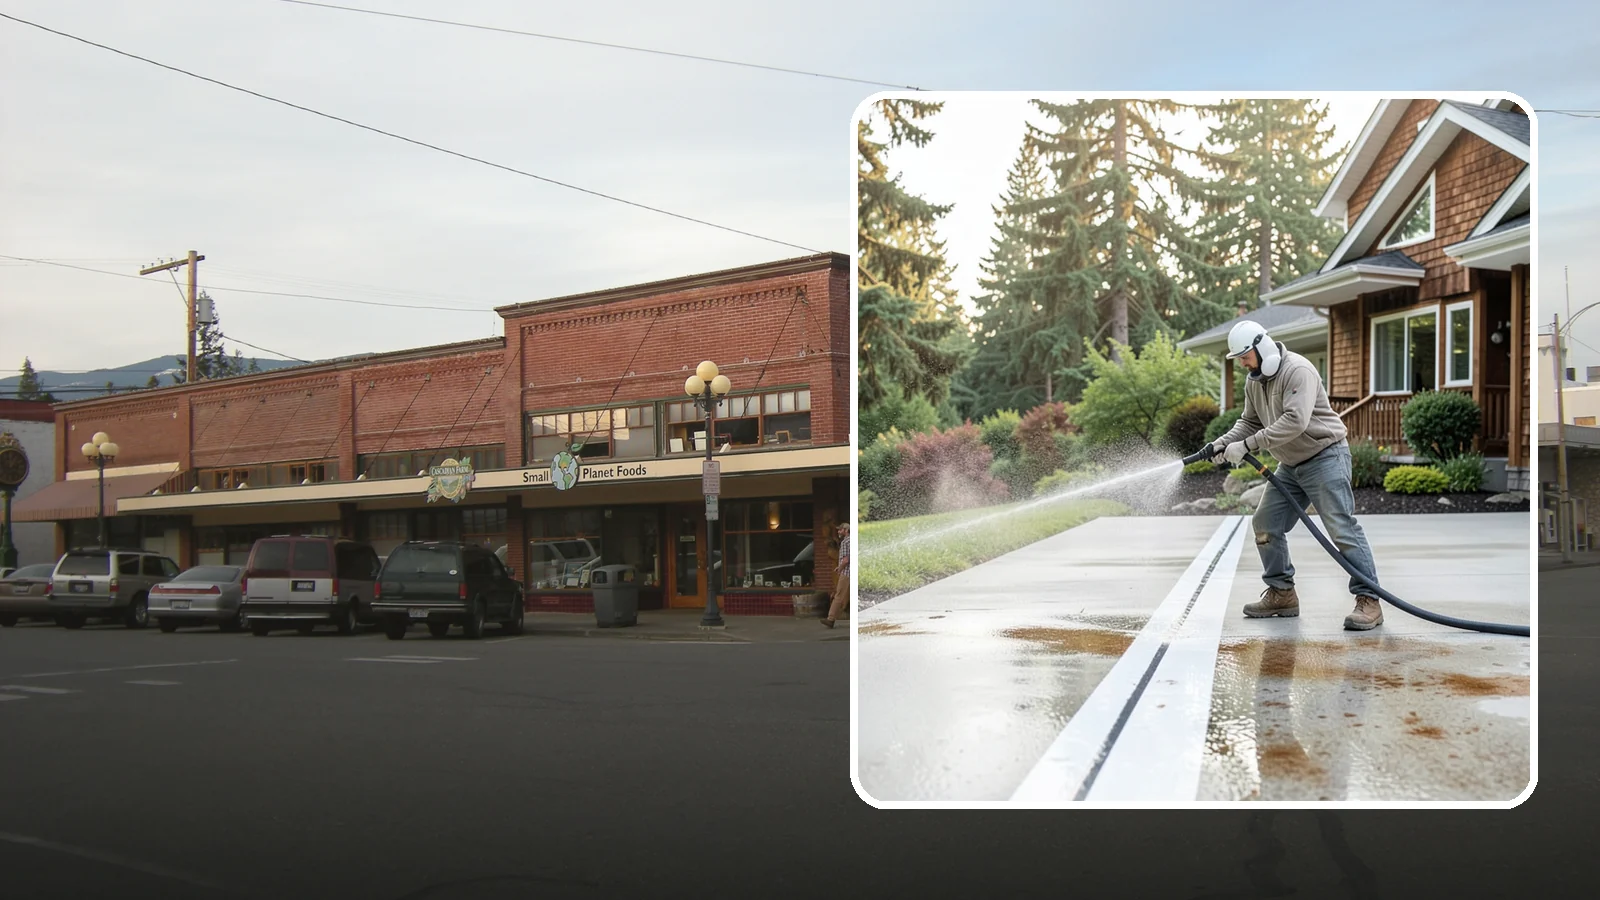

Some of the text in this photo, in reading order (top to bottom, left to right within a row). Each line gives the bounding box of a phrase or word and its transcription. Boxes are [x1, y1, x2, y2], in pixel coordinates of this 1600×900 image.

[523, 464, 647, 483] Small Planet Foods
